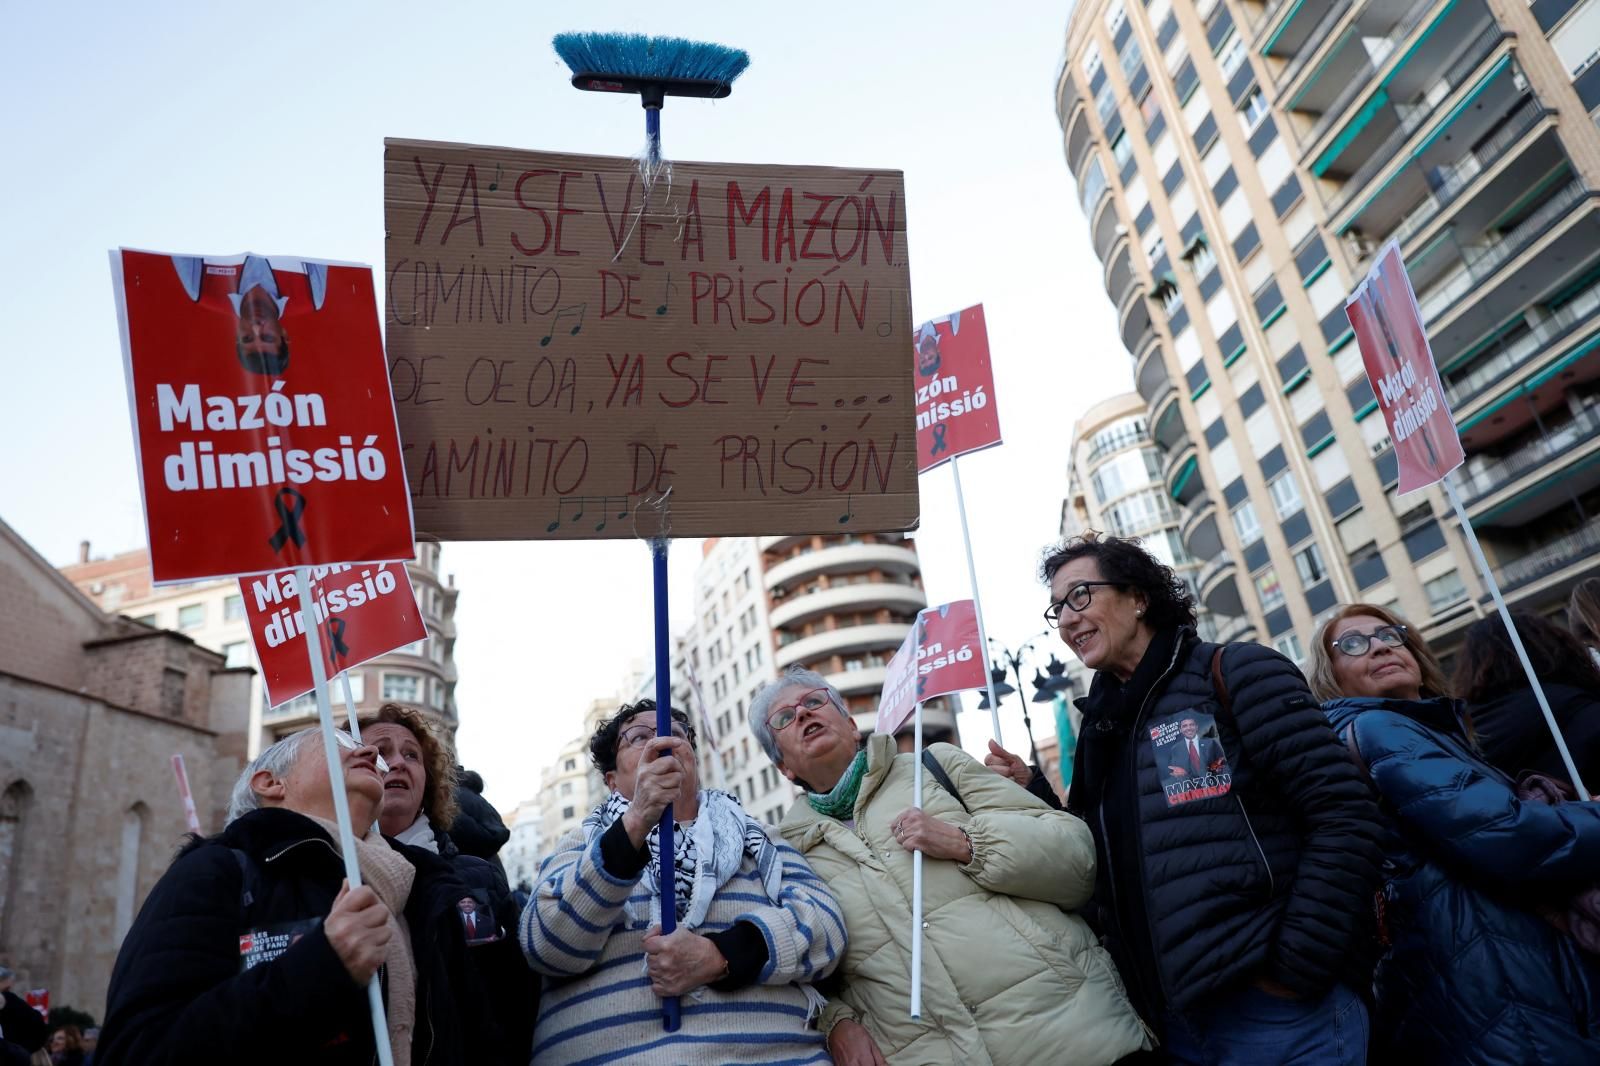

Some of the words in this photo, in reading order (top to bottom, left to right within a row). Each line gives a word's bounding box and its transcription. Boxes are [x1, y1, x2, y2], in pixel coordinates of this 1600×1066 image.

[413, 156, 484, 247] YA
[511, 169, 584, 256] SE
[594, 173, 664, 266] VE
[681, 179, 704, 262] A
[389, 254, 561, 327] CAMINITO
[598, 269, 647, 321] DE
[688, 264, 869, 335] PRISIÓN
[156, 380, 327, 432] Mazón
[465, 357, 516, 406] OE
[605, 353, 645, 408] YA
[658, 352, 729, 408] SE
[915, 373, 958, 407] zón
[1377, 356, 1417, 408] Mazón
[916, 385, 987, 432] missió
[1393, 376, 1438, 442] dimissió
[164, 434, 387, 492] dimissió
[627, 442, 678, 496] DE
[712, 412, 898, 496] PRISIÓN
[1166, 772, 1231, 798] MAZÓN
[246, 953, 261, 962] LES
[253, 931, 267, 940] LES
[254, 934, 289, 945] NOSTRES
[255, 944, 264, 952] DE
